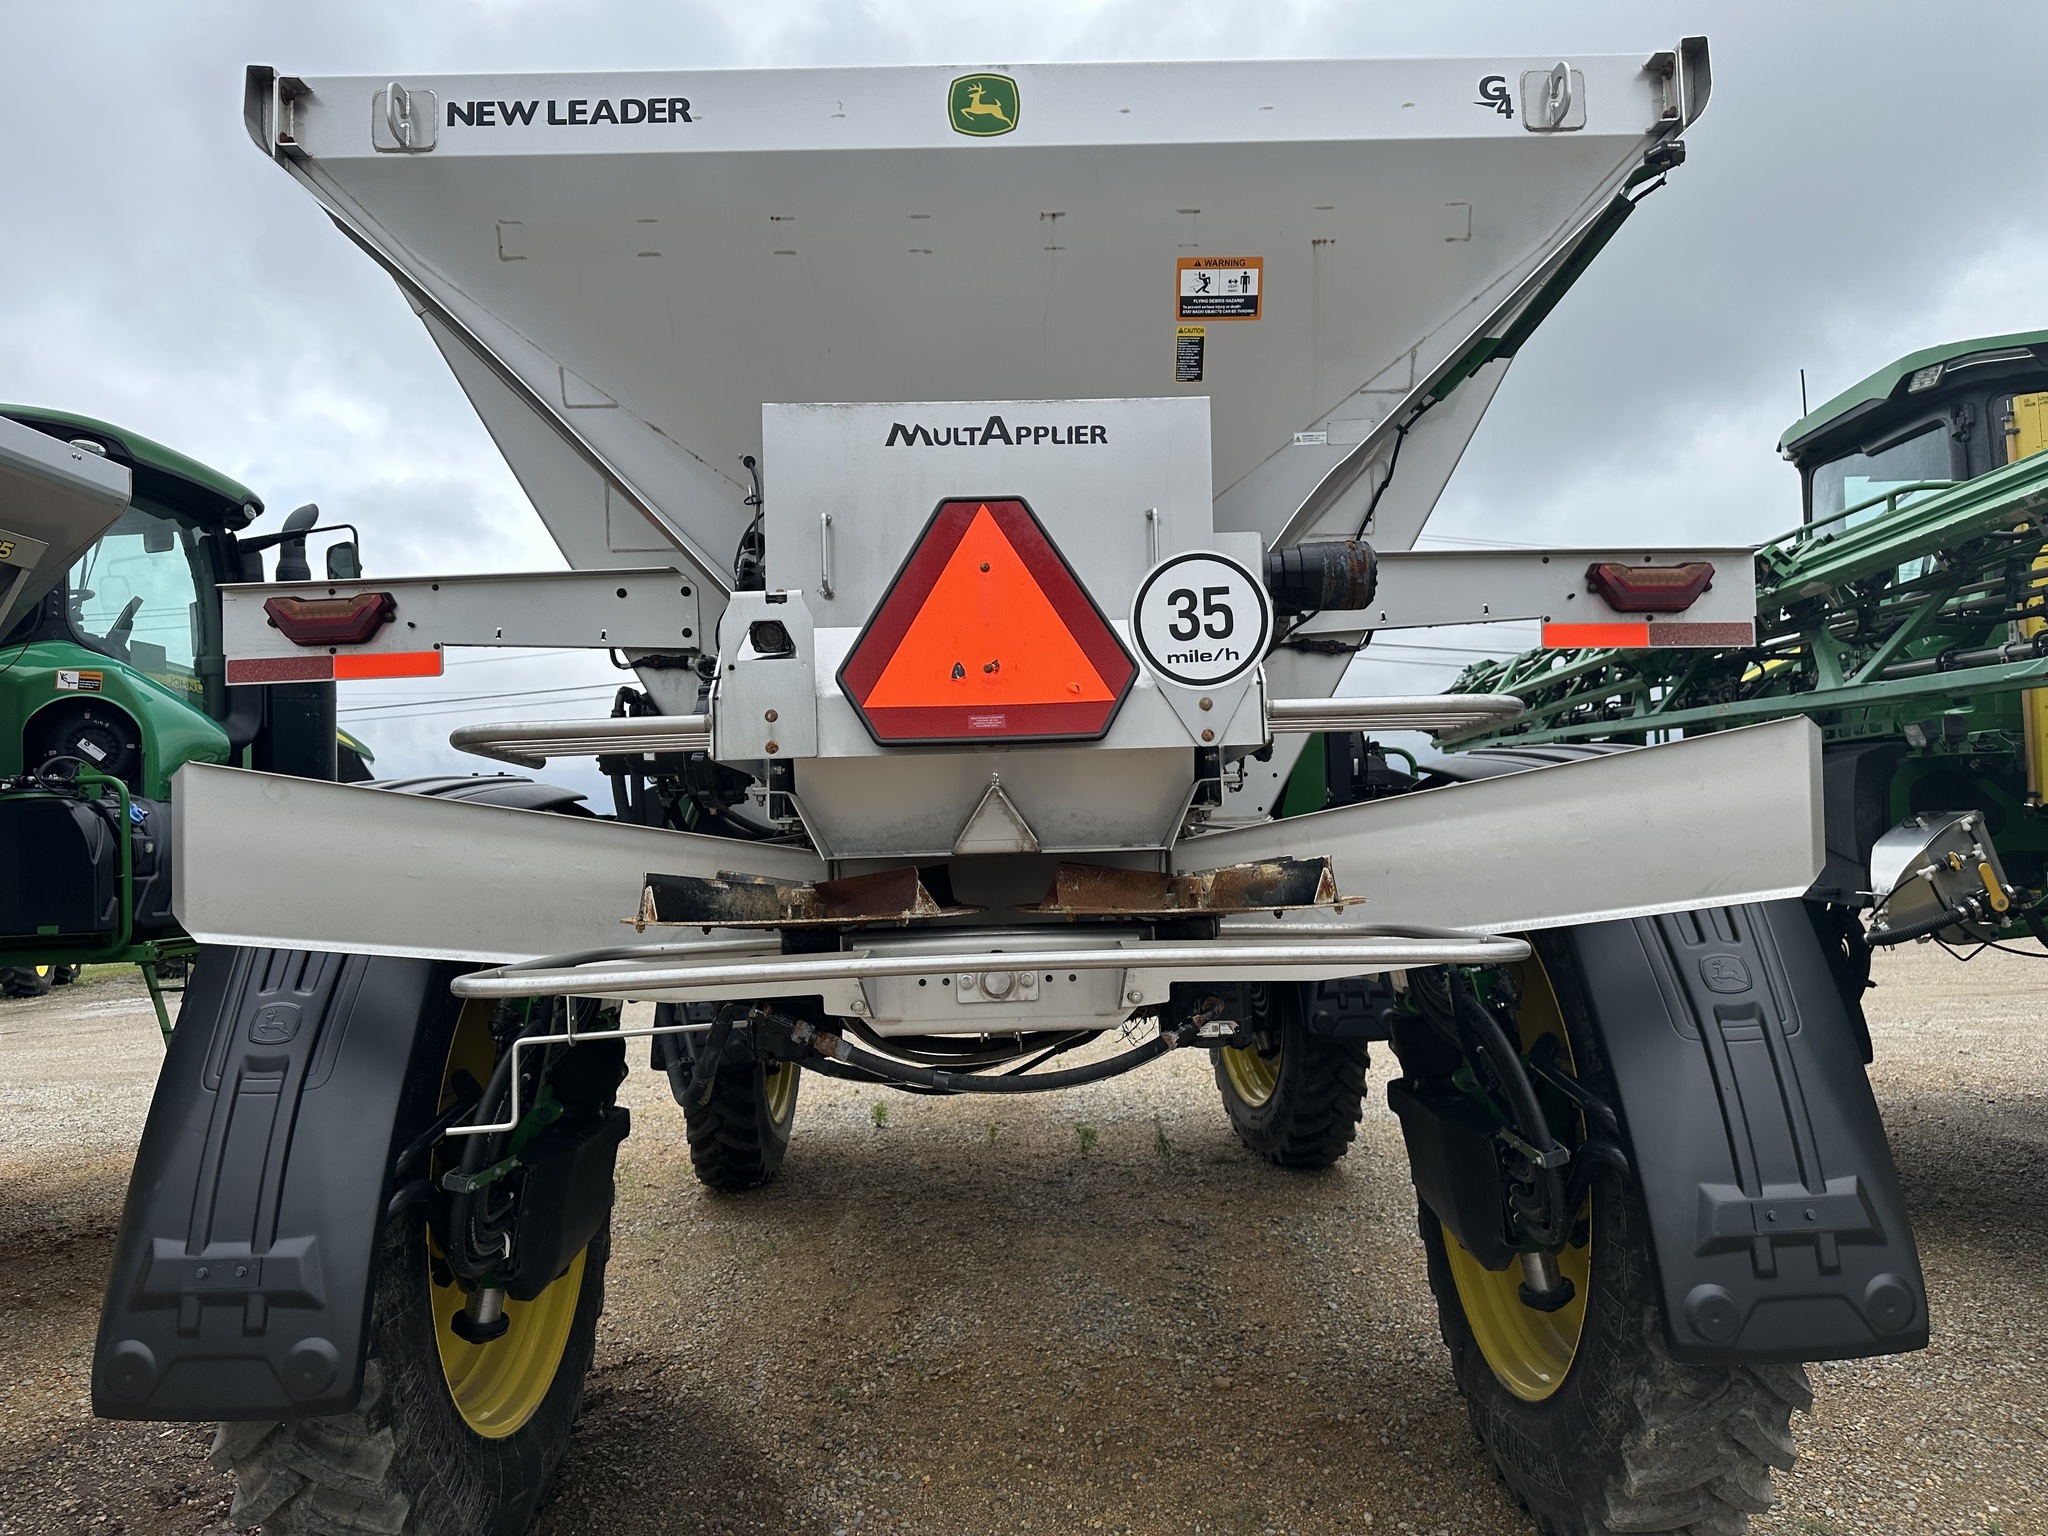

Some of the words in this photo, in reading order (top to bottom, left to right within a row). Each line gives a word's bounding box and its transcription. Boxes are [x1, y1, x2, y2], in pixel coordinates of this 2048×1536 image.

[1479, 75, 1514, 119] G4
[447, 100, 540, 127] NEW
[547, 98, 693, 125] LEADER
[1204, 259, 1246, 267] WARNING
[1167, 586, 1234, 641] 35
[1167, 648, 1240, 664] mile/h
